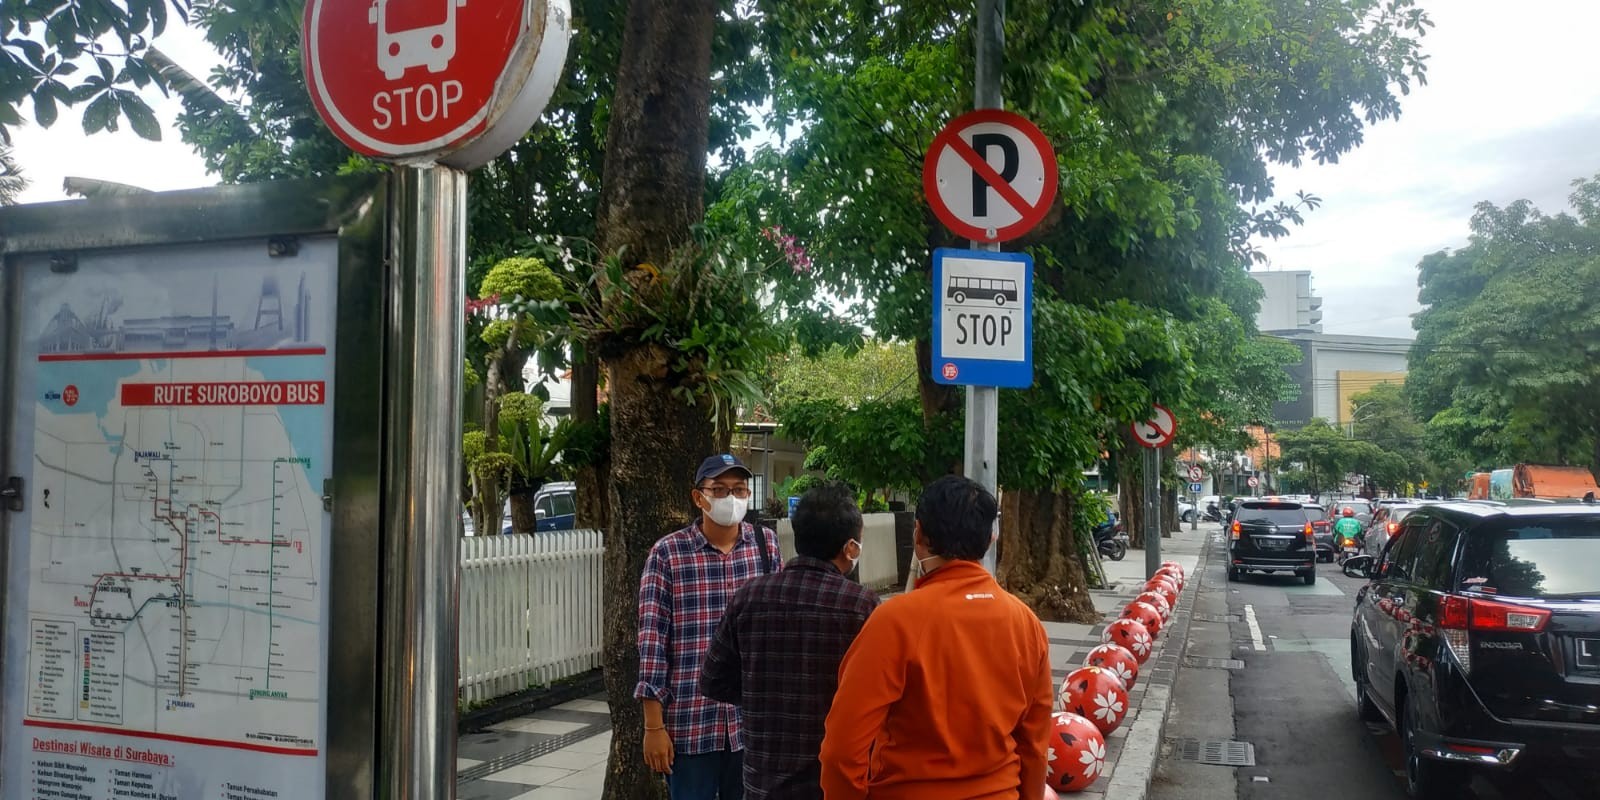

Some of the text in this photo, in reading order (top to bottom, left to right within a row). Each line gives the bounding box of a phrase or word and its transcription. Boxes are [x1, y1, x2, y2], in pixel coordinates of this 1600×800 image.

[373, 80, 463, 130] STOP
[972, 133, 1019, 217] P
[956, 314, 1012, 346] STOP
[154, 383, 320, 404] RUTE SUROBOYO BUS
[1581, 640, 1592, 656] L
[32, 737, 78, 754] Destinasi
[80, 742, 112, 759] Wisata
[114, 745, 124, 759] di
[126, 748, 169, 766] Surabaya
